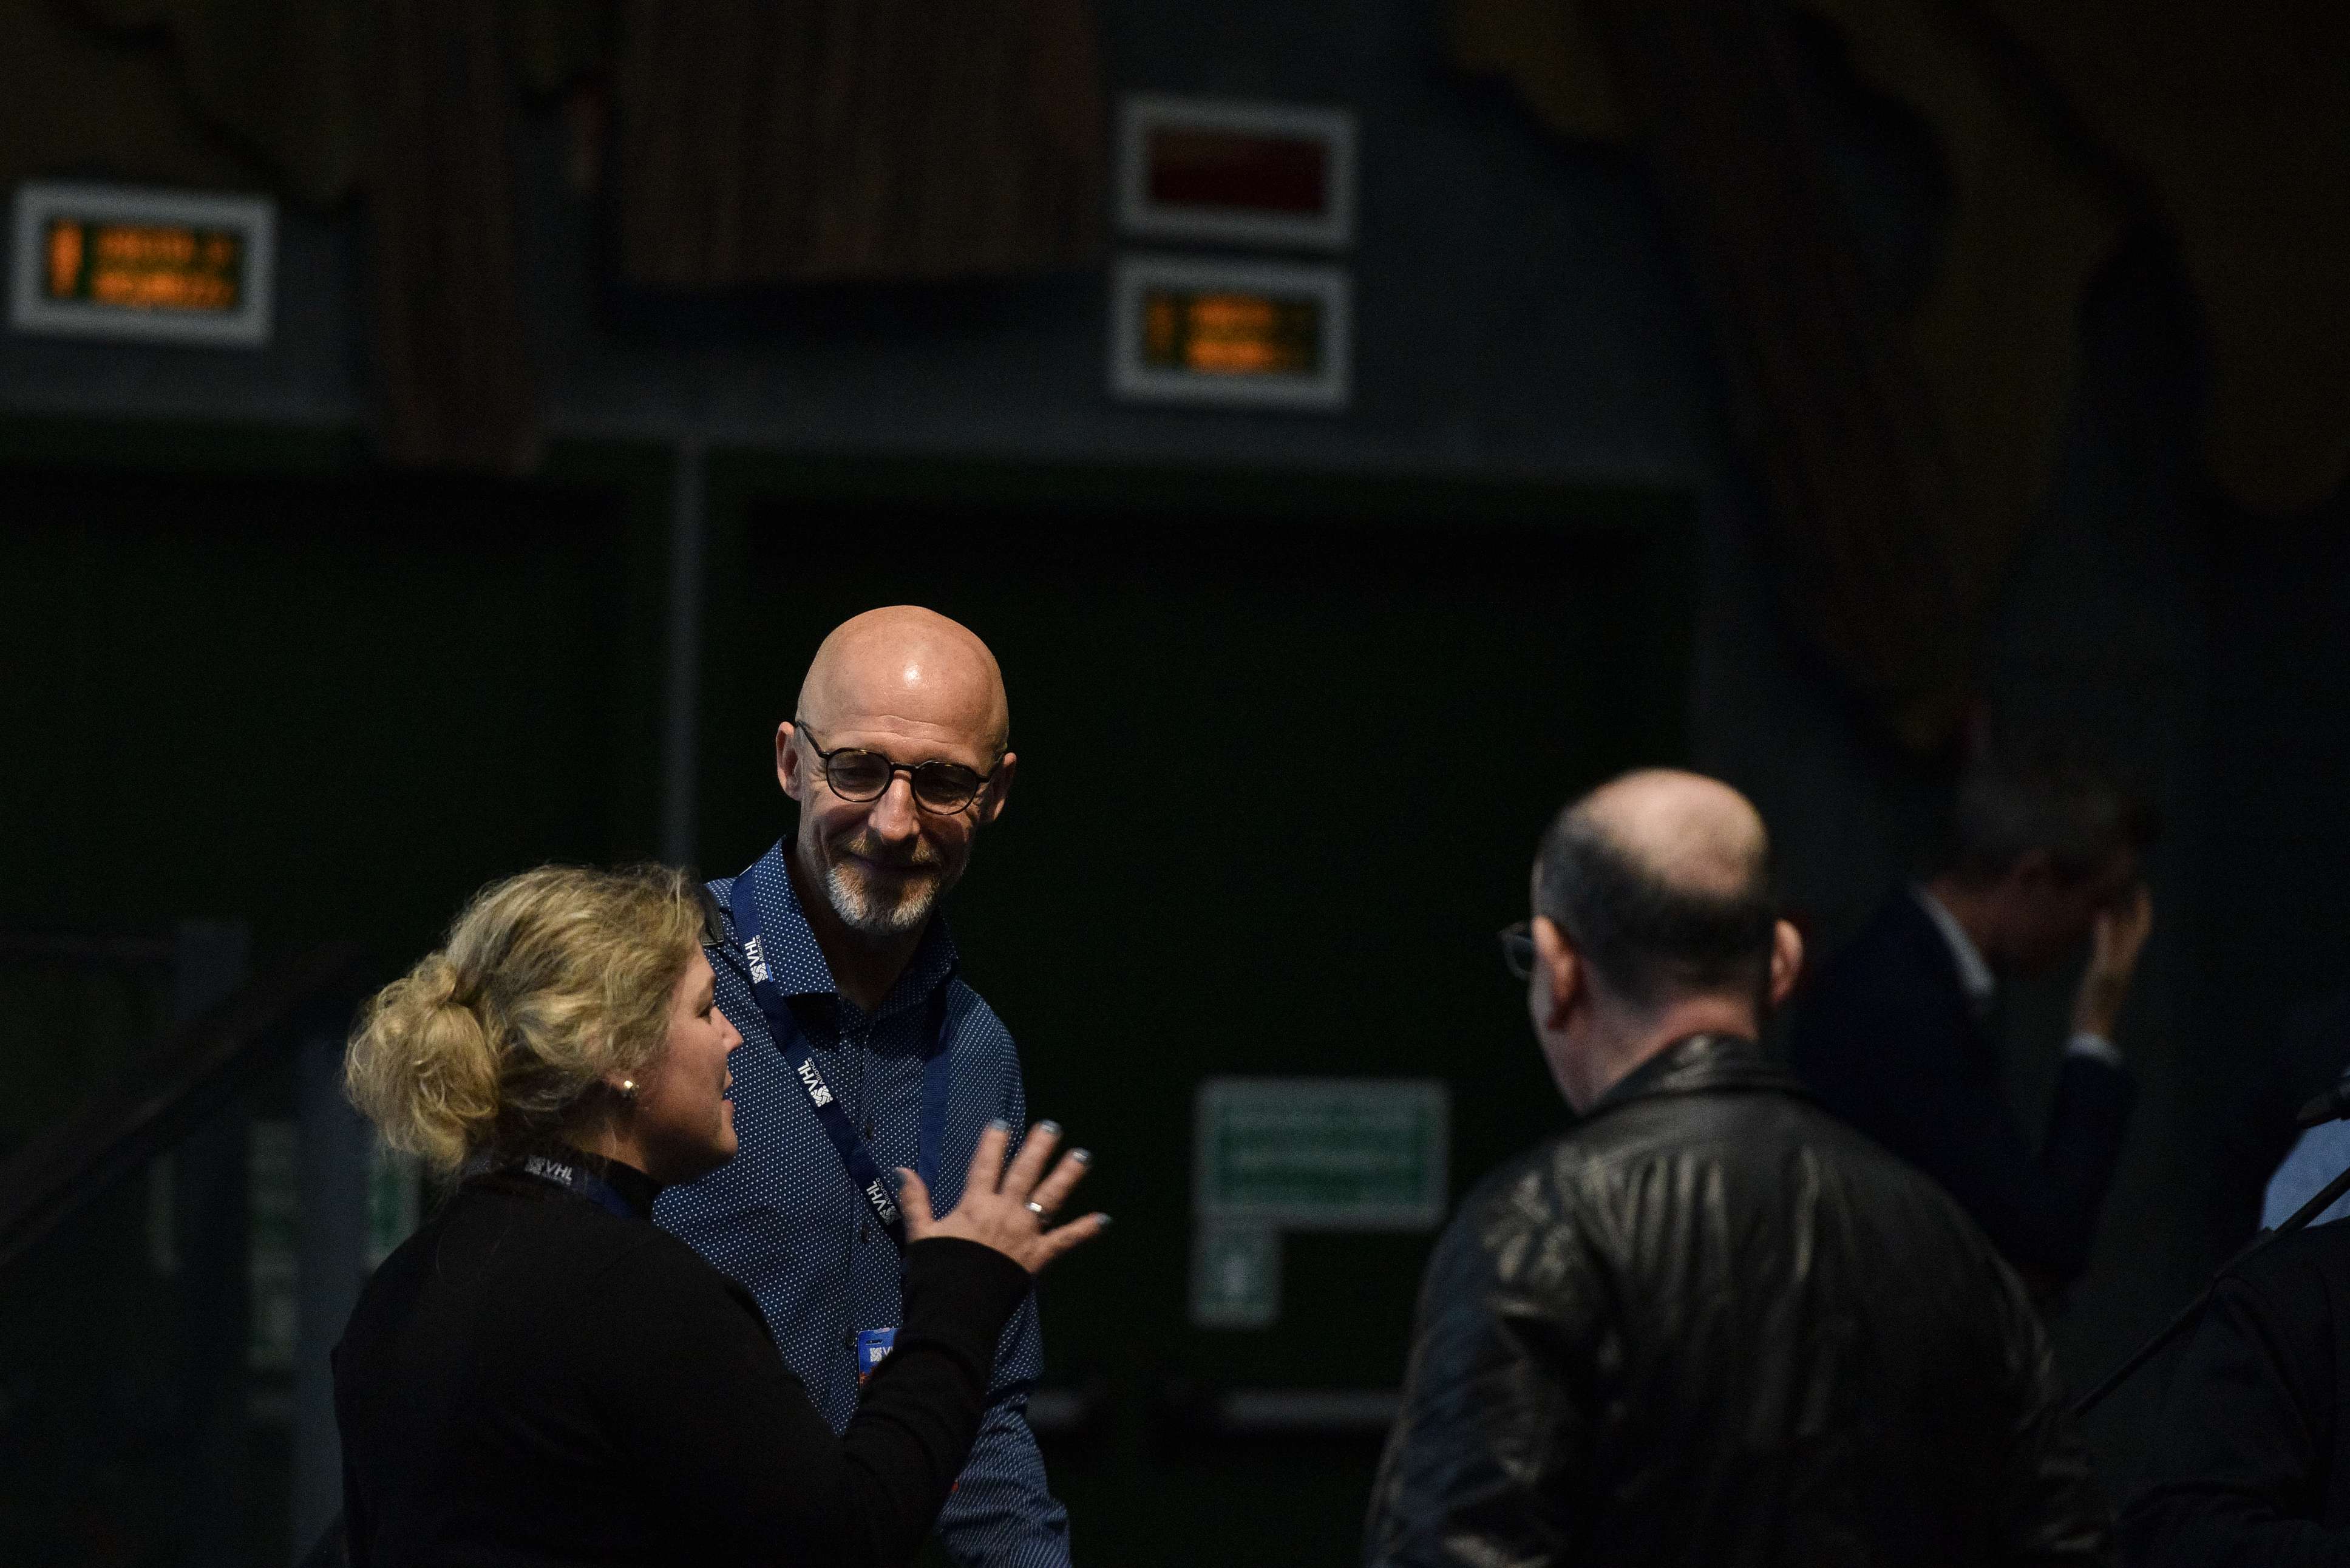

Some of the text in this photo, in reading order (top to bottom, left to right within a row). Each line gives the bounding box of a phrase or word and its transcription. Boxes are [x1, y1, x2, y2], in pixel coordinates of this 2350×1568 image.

[744, 937, 760, 967] VHL
[755, 935, 766, 962] Alliance
[797, 1060, 818, 1092] VHL
[807, 1057, 825, 1084] Alliance
[866, 1181, 886, 1211] VHL
[875, 1178, 893, 1204] Alliance
